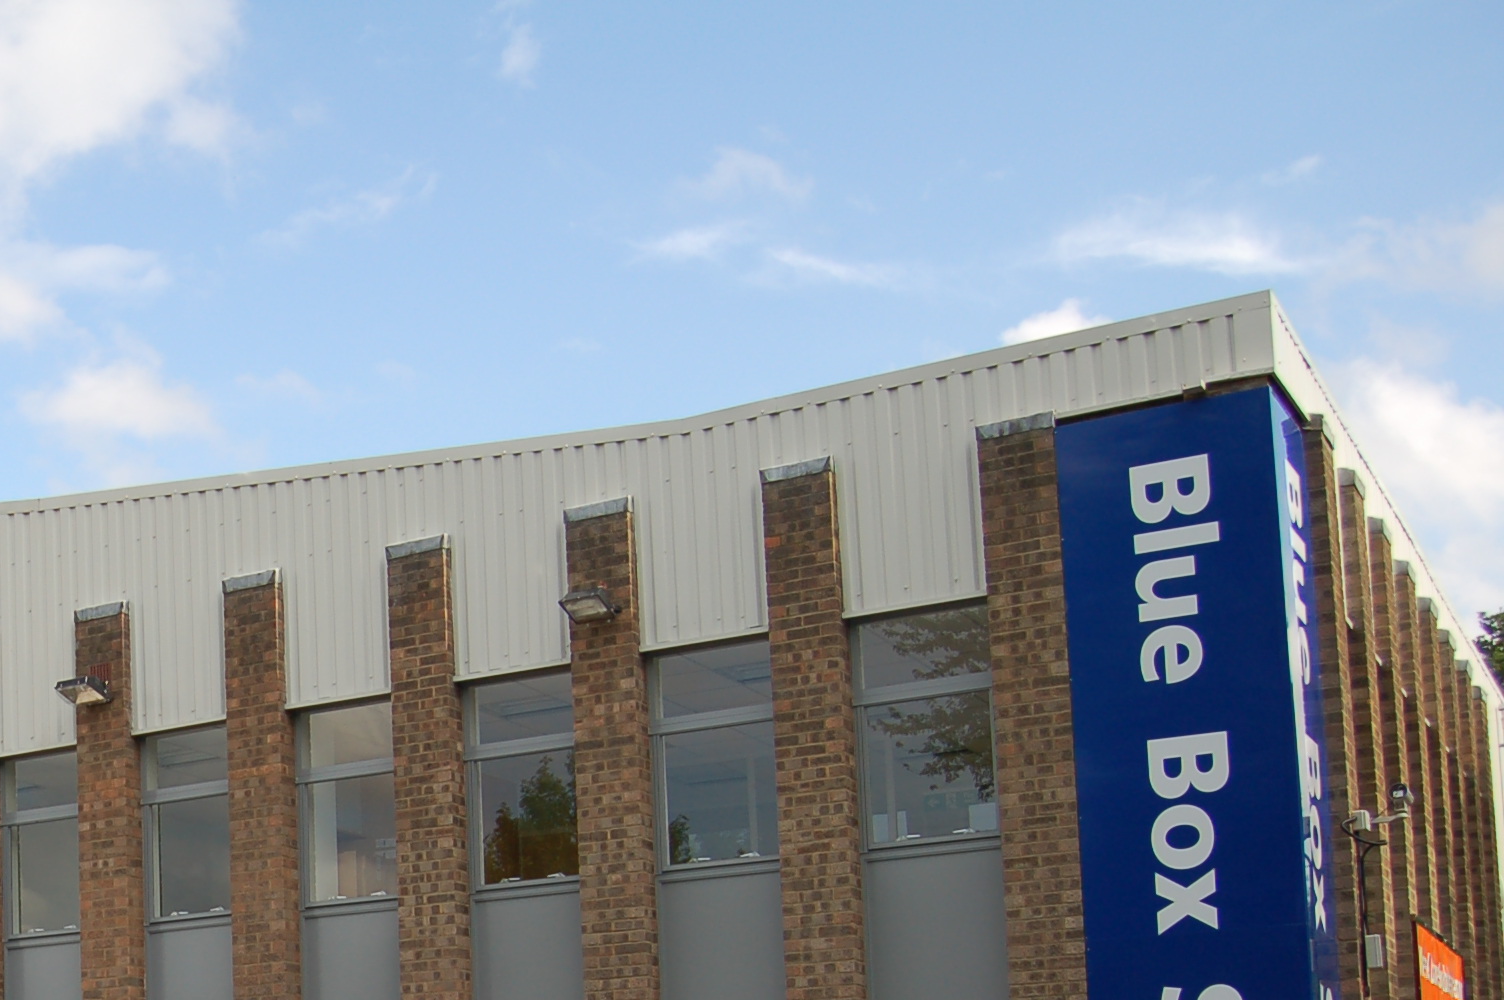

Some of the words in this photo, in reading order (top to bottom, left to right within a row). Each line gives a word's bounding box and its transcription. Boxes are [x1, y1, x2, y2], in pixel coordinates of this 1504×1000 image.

[1128, 453, 1221, 685] Blue
[1285, 459, 1311, 685] Blue
[1304, 734, 1327, 931] Box
[1147, 731, 1230, 935] Box
